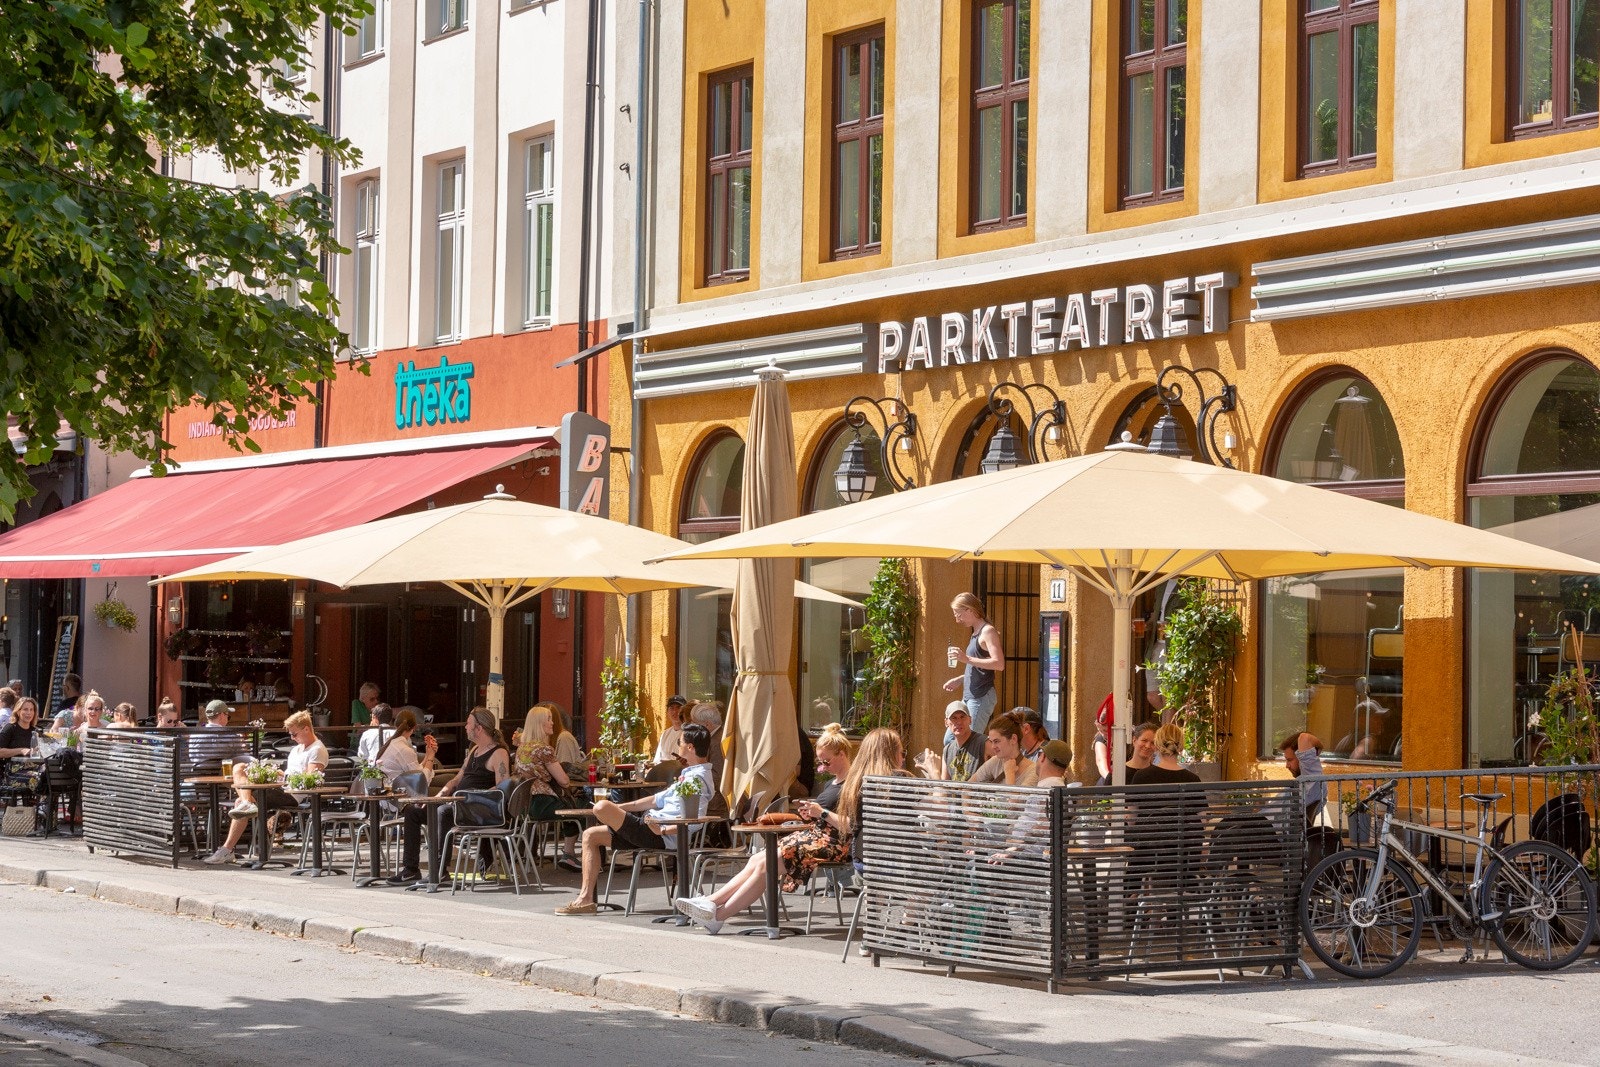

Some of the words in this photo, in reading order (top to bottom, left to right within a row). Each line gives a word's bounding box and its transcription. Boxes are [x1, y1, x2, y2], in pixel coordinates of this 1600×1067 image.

[878, 272, 1227, 374] PARKTEATRET
[395, 355, 474, 429] theka
[188, 420, 216, 439] INDIAN
[248, 413, 271, 431] OOD
[1052, 583, 1061, 599] 11
